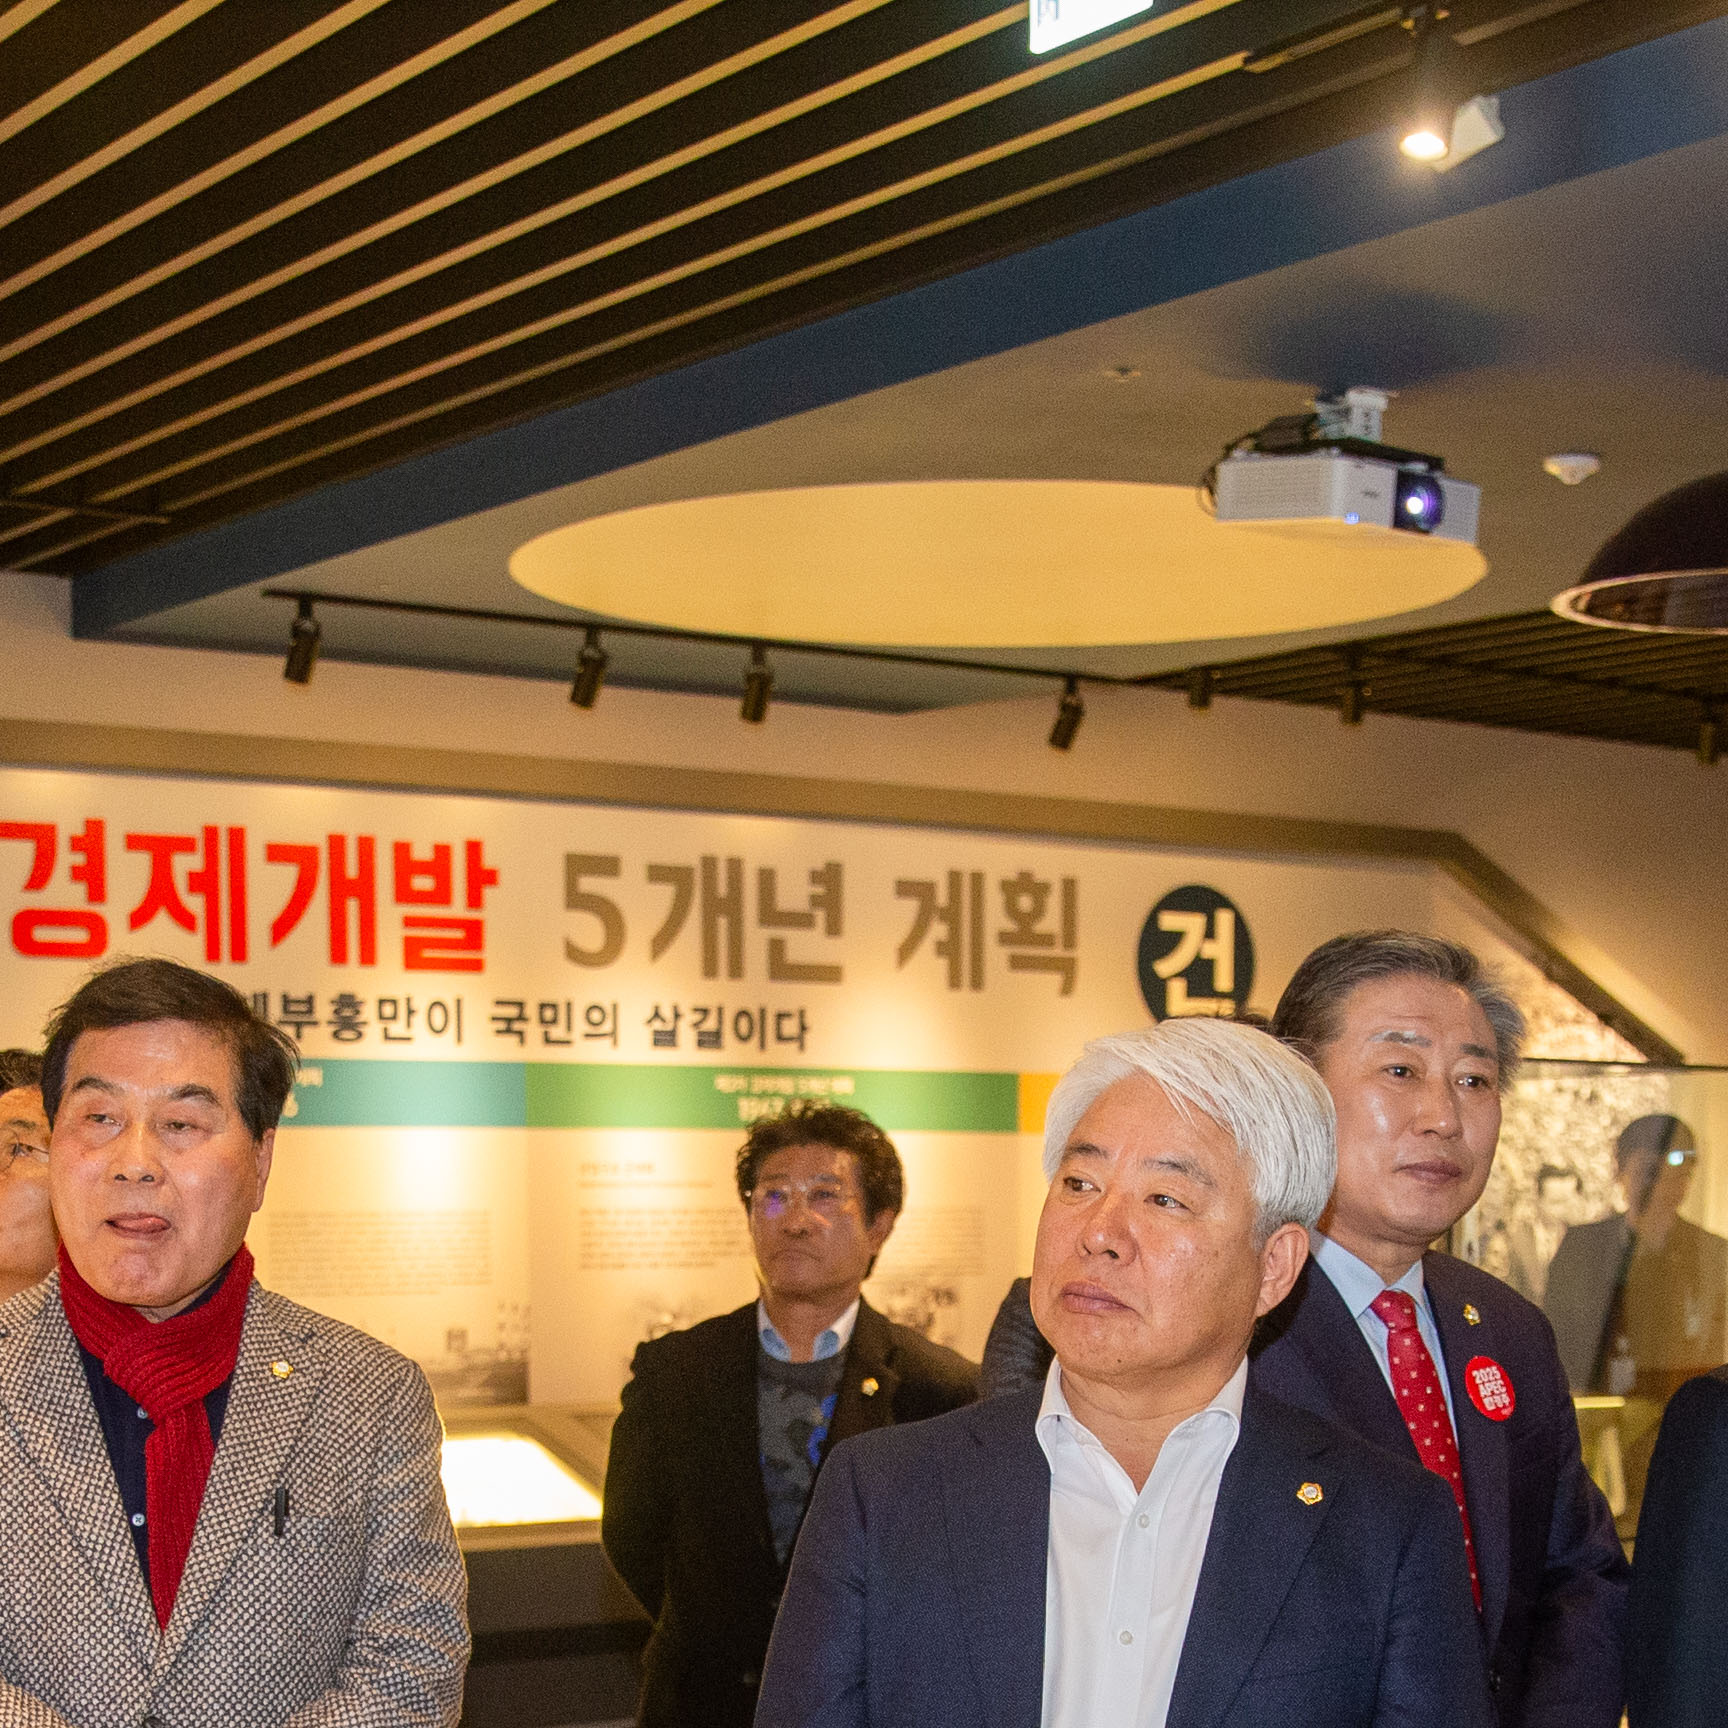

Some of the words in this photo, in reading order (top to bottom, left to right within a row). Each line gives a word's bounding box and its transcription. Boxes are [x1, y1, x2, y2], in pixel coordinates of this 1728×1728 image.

[563, 851, 845, 984] 5개년
[893, 868, 1079, 998] 계획
[1152, 907, 1236, 1018] 건
[490, 998, 620, 1048] 국민의
[645, 1002, 810, 1053] 살길이다
[1472, 1366, 1501, 1384] 2025
[1478, 1380, 1507, 1398] APEC
